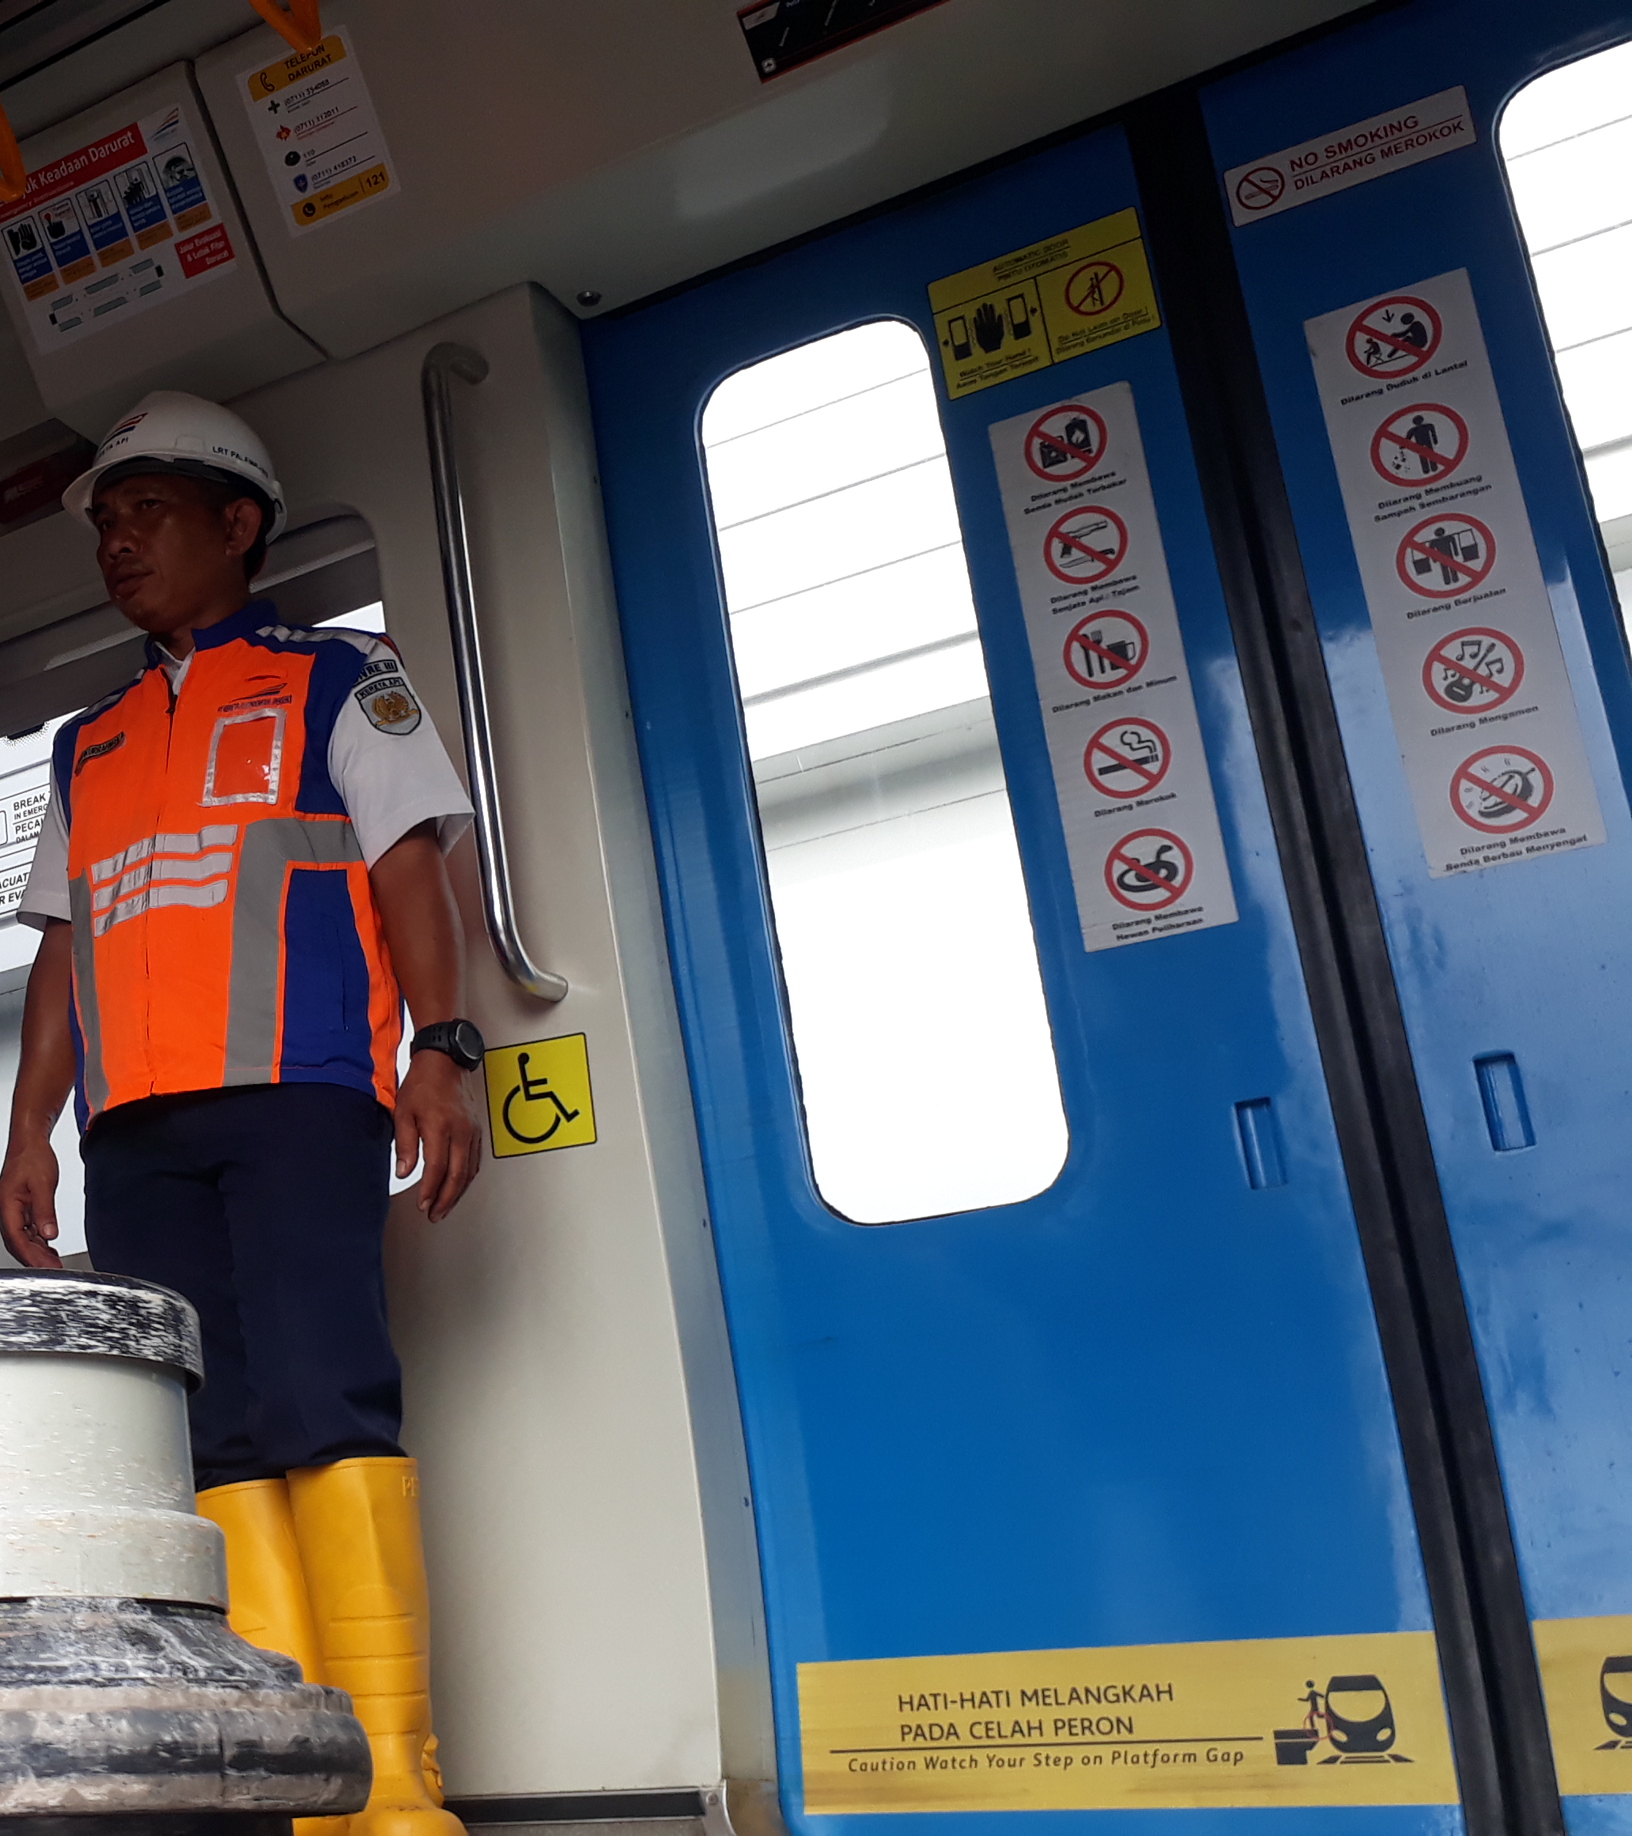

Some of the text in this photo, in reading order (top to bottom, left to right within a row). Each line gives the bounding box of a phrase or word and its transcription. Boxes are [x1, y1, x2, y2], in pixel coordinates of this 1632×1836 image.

[288, 54, 332, 81] DARURAT
[1290, 115, 1418, 171] NO SMOKING
[1294, 121, 1464, 190] DILARANG MEROKOK
[38, 156, 88, 188] Keadaan
[88, 131, 136, 162] Darurat
[366, 172, 385, 188] 121
[1341, 388, 1383, 405] Dilarang
[1386, 376, 1419, 391] Duduk
[1435, 360, 1467, 375] Lantai
[213, 446, 229, 455] LRT
[1374, 484, 1492, 522] Sampah Sembarangan
[1378, 475, 1482, 509] Dilarang Membuang
[1051, 589, 1087, 604] Dilarang
[1407, 588, 1506, 619] Dilarang Berjualan
[1052, 699, 1090, 713] Dilarang
[1092, 690, 1124, 702] Makan
[1126, 685, 1143, 694] dan
[1430, 706, 1539, 737] Dilarang Mengamen
[13, 793, 47, 811] BREAK
[14, 804, 49, 820] IN EMERG
[1094, 804, 1134, 818] Dilarang
[15, 818, 44, 835] PECA
[1460, 828, 1566, 856] Dilarang Membawa
[1483, 849, 1523, 863] Berbau
[1526, 834, 1587, 853] Menyengat
[1112, 917, 1152, 931] Dilarang
[898, 1682, 1174, 1712] HATI-HATI MELANGKAH
[900, 1716, 1134, 1742] PADA CELAH PERON
[848, 1748, 1244, 1773] Caution Watch Your Step on Platform Gap
